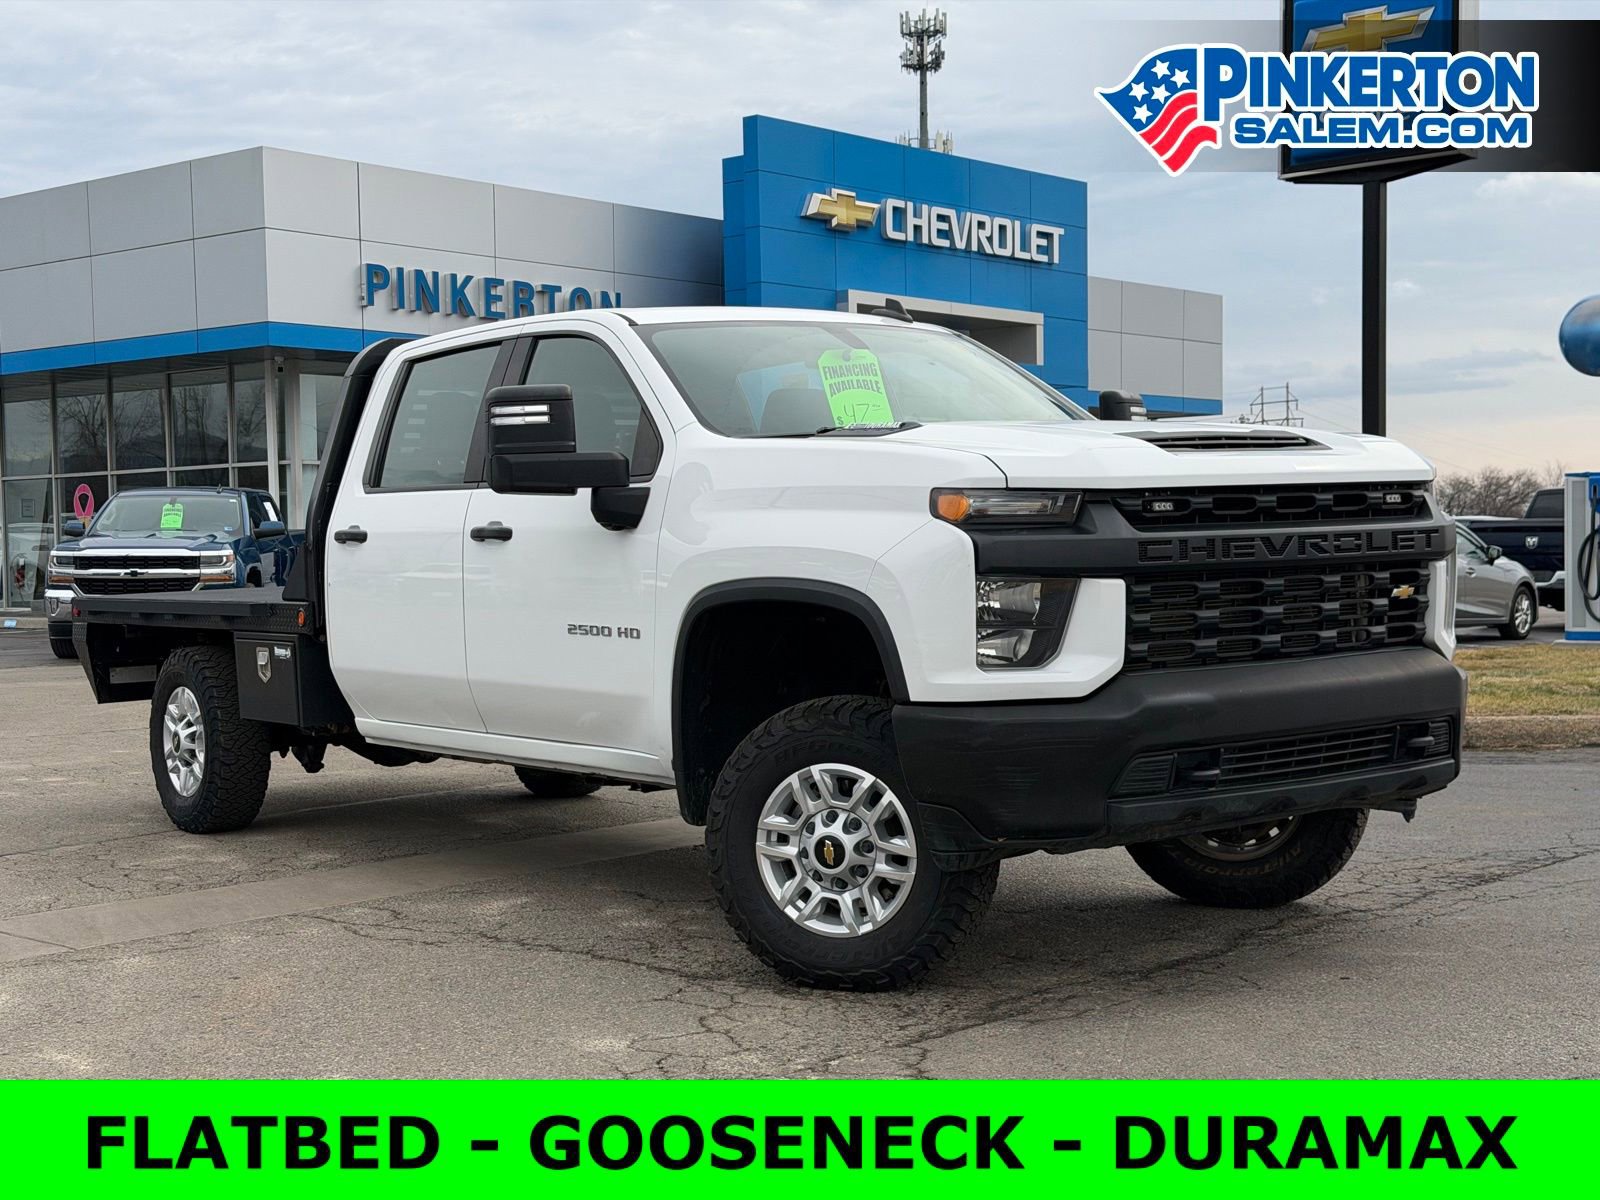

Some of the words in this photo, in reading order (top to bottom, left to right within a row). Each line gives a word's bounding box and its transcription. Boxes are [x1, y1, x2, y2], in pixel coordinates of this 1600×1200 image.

[885, 198, 1065, 264] CHEVROLET
[822, 362, 879, 381] FINANCING
[828, 379, 883, 398] AVAILABLE
[1137, 528, 1440, 564] CHEVROLET
[567, 624, 612, 637] 2500
[617, 627, 641, 640] HD
